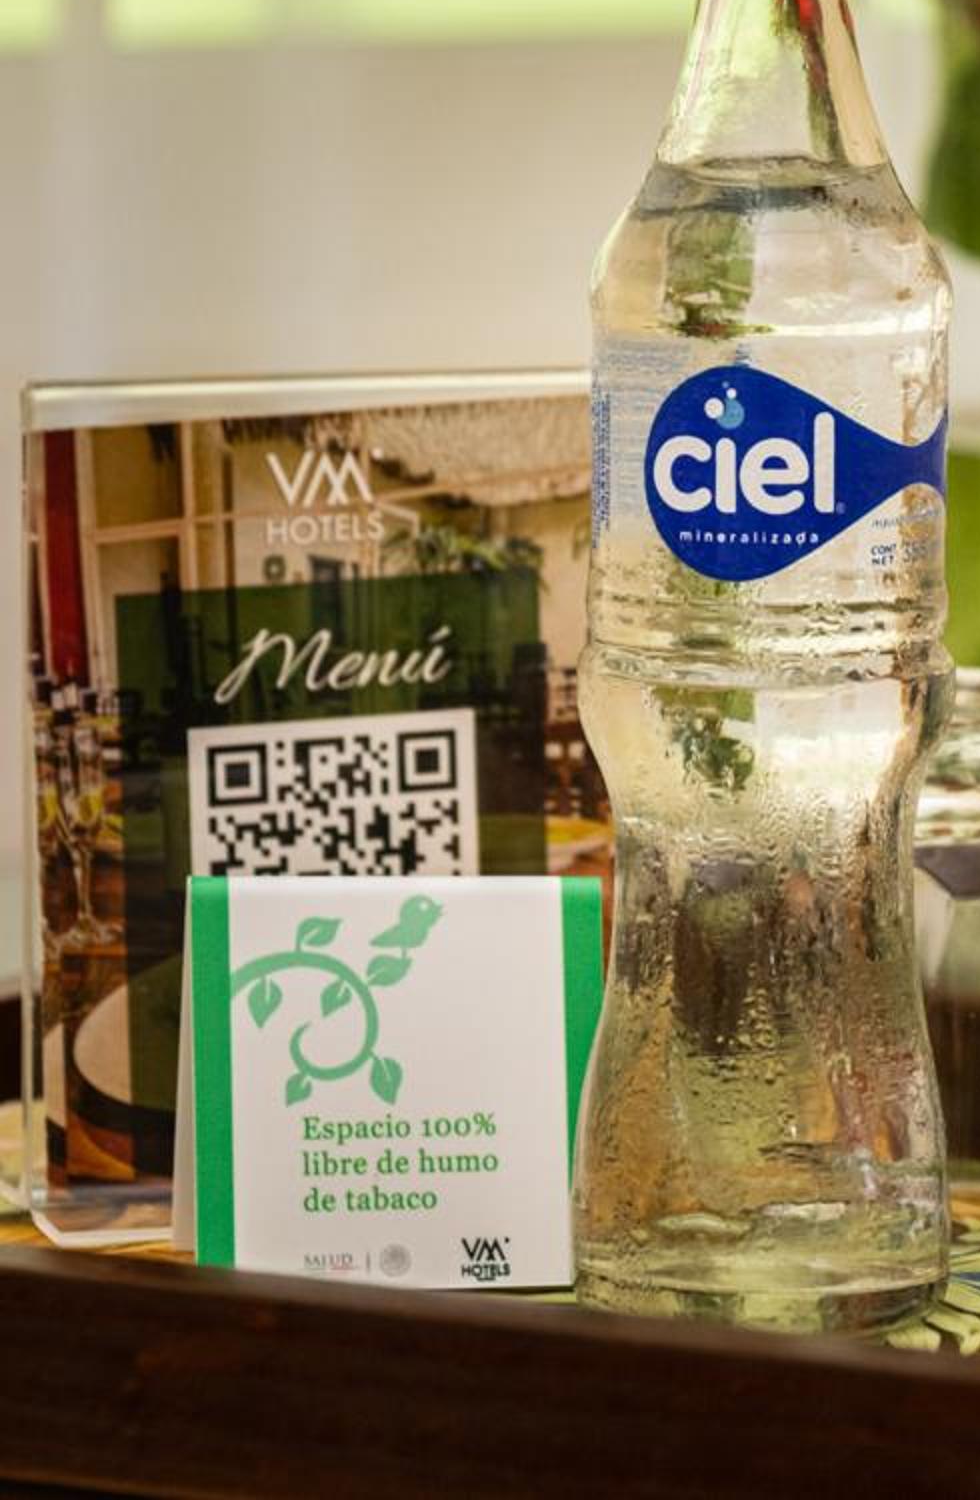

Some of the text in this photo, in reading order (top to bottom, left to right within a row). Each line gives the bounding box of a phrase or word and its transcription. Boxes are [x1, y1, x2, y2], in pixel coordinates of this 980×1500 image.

[653, 411, 836, 515] ciel
[265, 509, 386, 545] HOTELS
[678, 529, 820, 545] mineralizada
[213, 624, 452, 704] Menú
[303, 1111, 497, 1146] Espacio 100%
[303, 1147, 499, 1177] libre de humo
[303, 1184, 438, 1213] de tabaco
[461, 1263, 511, 1278] HOTELS
